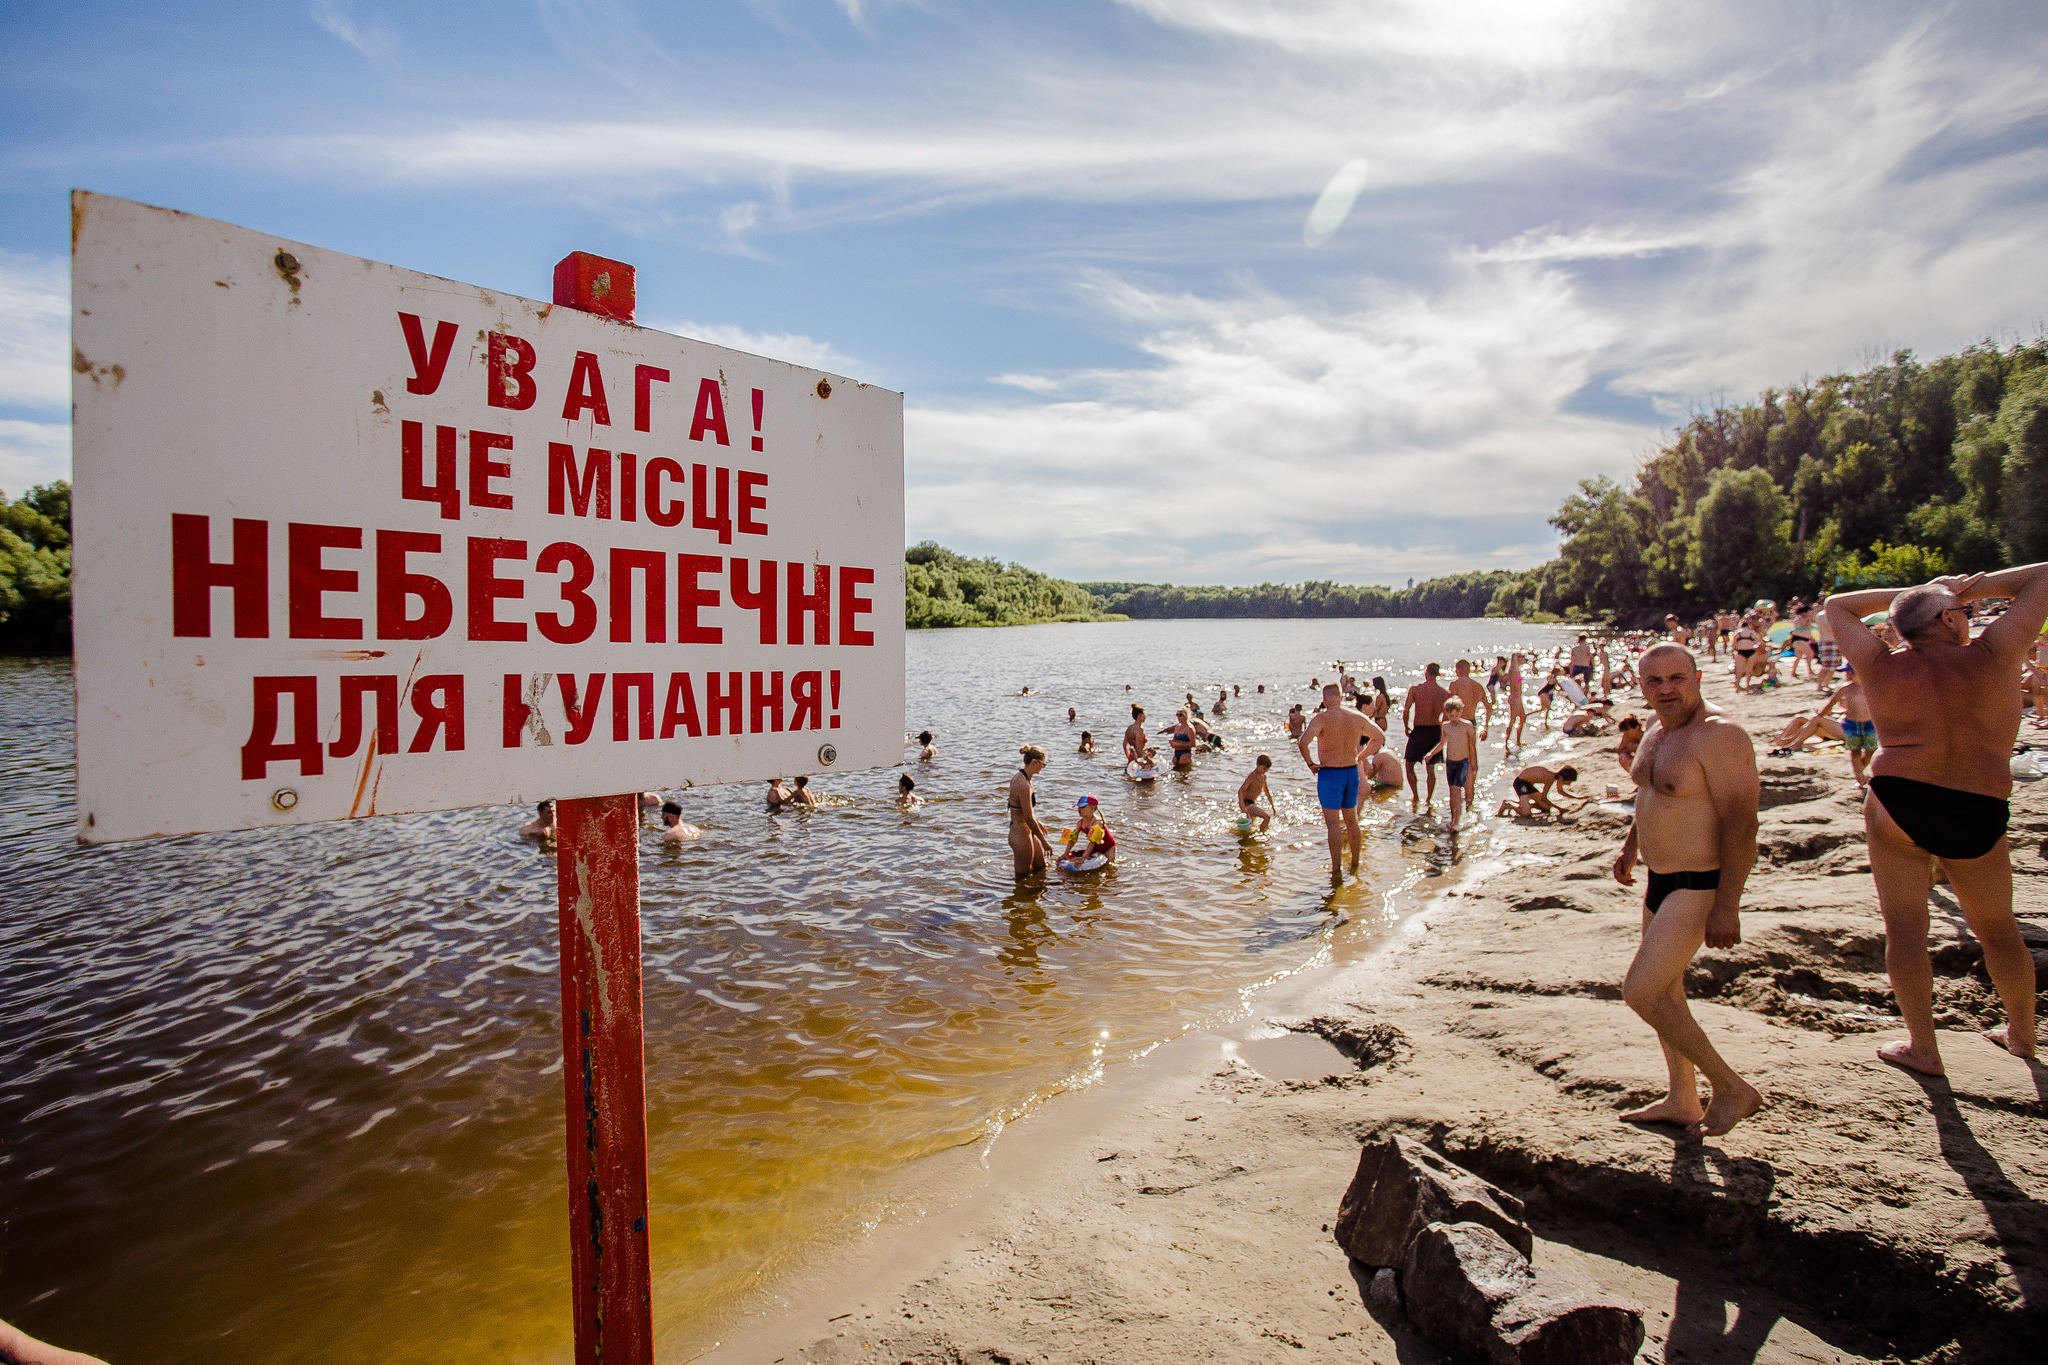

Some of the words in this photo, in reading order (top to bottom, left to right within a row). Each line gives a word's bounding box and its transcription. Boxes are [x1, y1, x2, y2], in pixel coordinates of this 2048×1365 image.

[398, 312, 765, 453] УВАГА!
[401, 420, 514, 521] ЦЕ
[548, 441, 769, 545] МІСЦЕ
[172, 513, 875, 647] НЕБЕЗПЕЧНЕ
[241, 674, 466, 781] ДЛЯ
[502, 669, 842, 749] КУПАННЯ!
